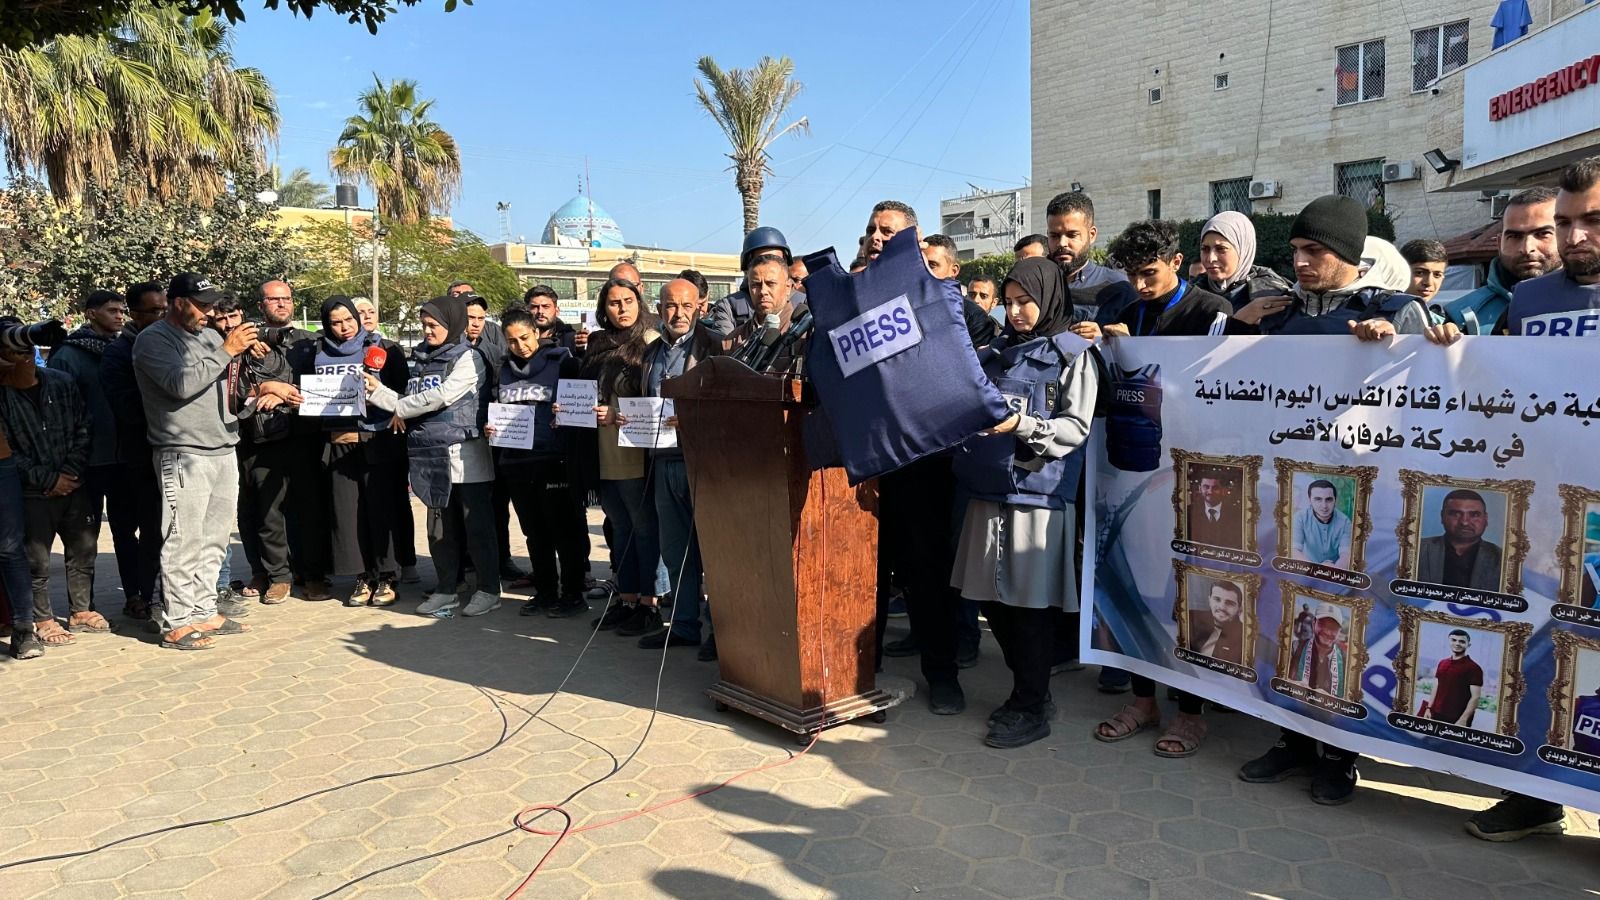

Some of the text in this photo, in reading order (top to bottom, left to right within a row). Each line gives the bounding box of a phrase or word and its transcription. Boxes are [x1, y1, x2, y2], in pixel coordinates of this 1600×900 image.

[1489, 55, 1600, 121] EMERGENCY
[836, 306, 912, 363] PRESS
[1116, 388, 1145, 403] PRESS
[1195, 378, 1272, 406] الفضائية
[1275, 383, 1322, 409] اليوم
[1394, 385, 1441, 410] قناة
[1324, 385, 1391, 411] القدس
[1445, 388, 1516, 419] شهداء
[1520, 392, 1557, 423] من
[1269, 416, 1525, 469] في معركة طوفان الأقصى
[1314, 566, 1332, 576] الصحفي
[1332, 571, 1347, 580] الزميل
[1347, 575, 1364, 585] الشهيد
[1395, 585, 1416, 594] هدروس
[1425, 588, 1443, 597] محمود
[1443, 592, 1455, 600] جبر
[1459, 591, 1483, 603] الصحفي
[1483, 596, 1502, 607] الزميل
[1502, 598, 1523, 608] الشهيد
[1555, 607, 1577, 618] الدين
[1578, 611, 1592, 621] خير
[1209, 660, 1227, 669] الصحفي
[1306, 692, 1324, 702] الصحفي
[1324, 699, 1341, 709] الزميل
[1341, 705, 1359, 714] الشهيد
[1414, 722, 1433, 731] فارس
[1438, 726, 1467, 738] الصحفي
[1467, 732, 1491, 744] الزميل
[1490, 737, 1515, 749] الشهيد
[1568, 755, 1578, 765] أبو
[1577, 758, 1592, 767] نصر
